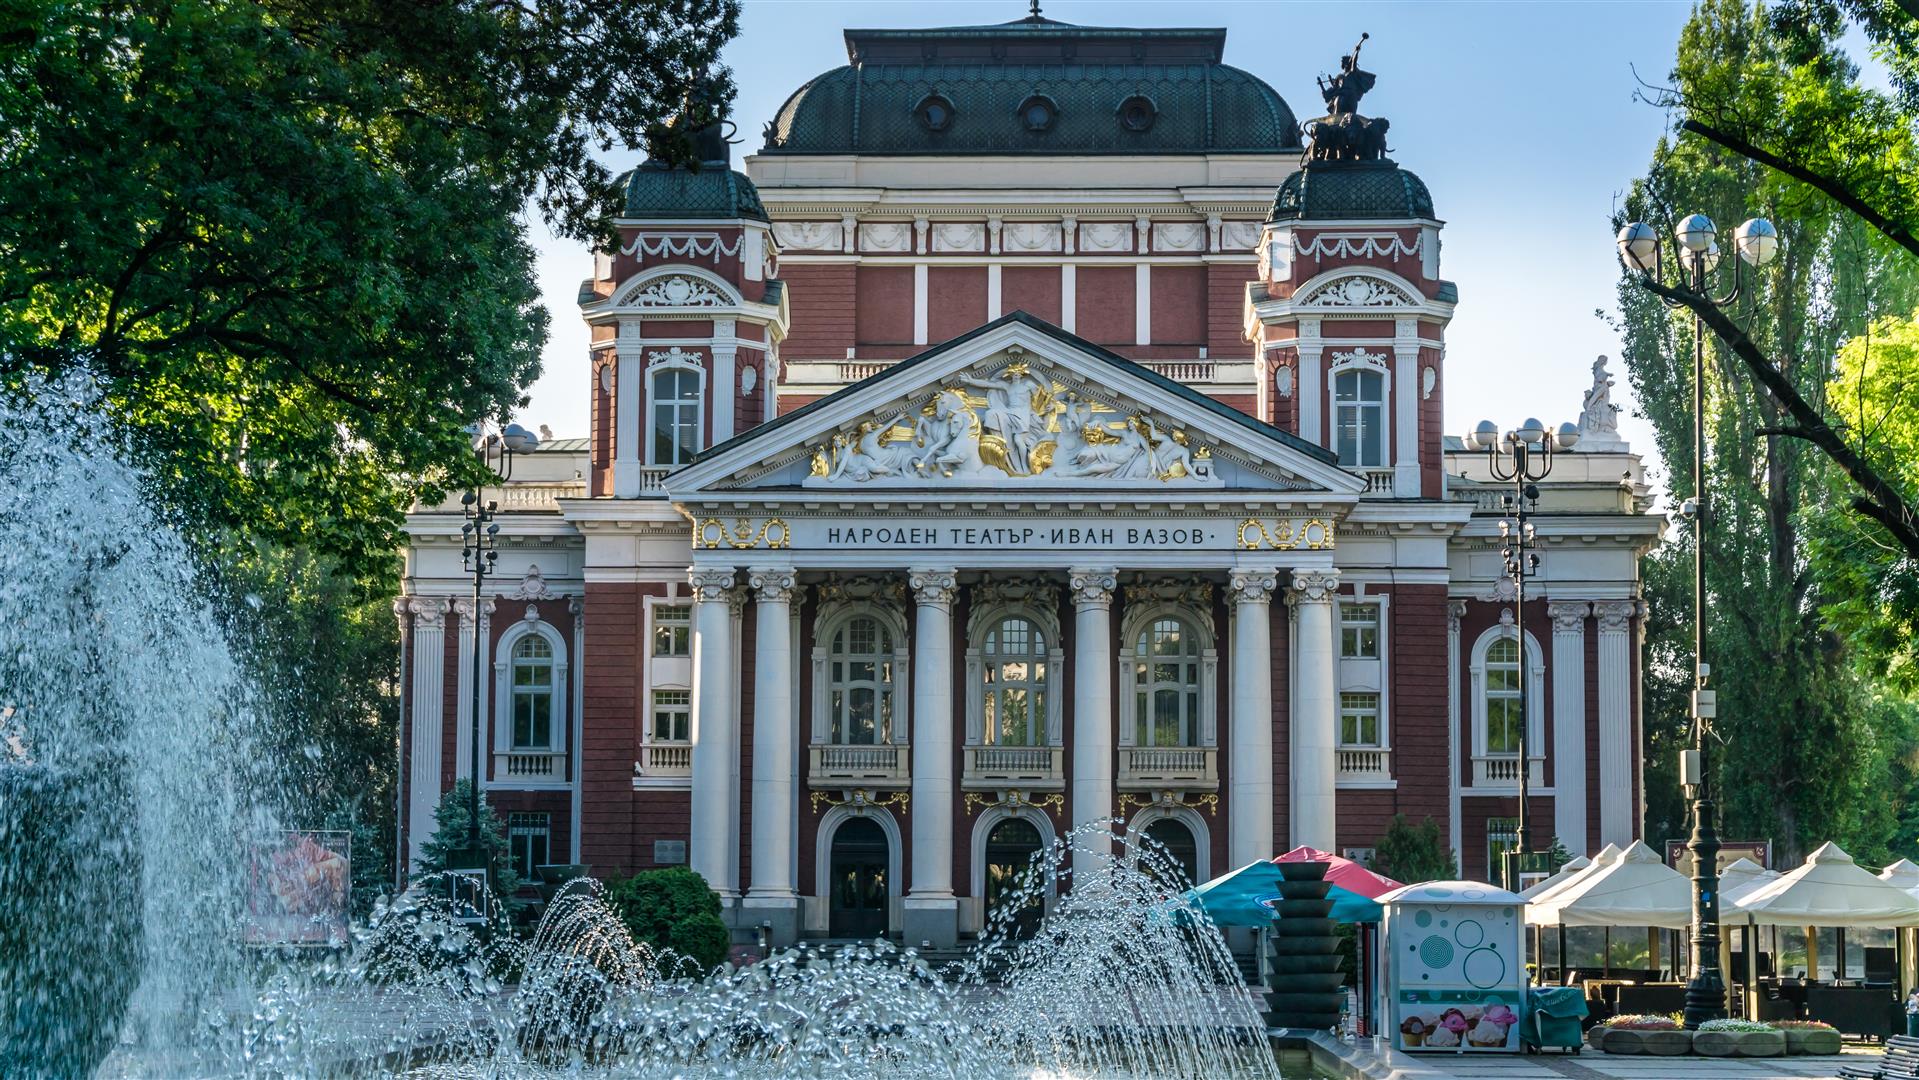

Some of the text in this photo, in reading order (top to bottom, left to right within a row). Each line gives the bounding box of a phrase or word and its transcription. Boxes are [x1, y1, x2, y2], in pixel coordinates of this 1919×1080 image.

[828, 527, 1204, 545] НАРОДЕН ТЕАТЪР ИВАН ВАЗОВ
